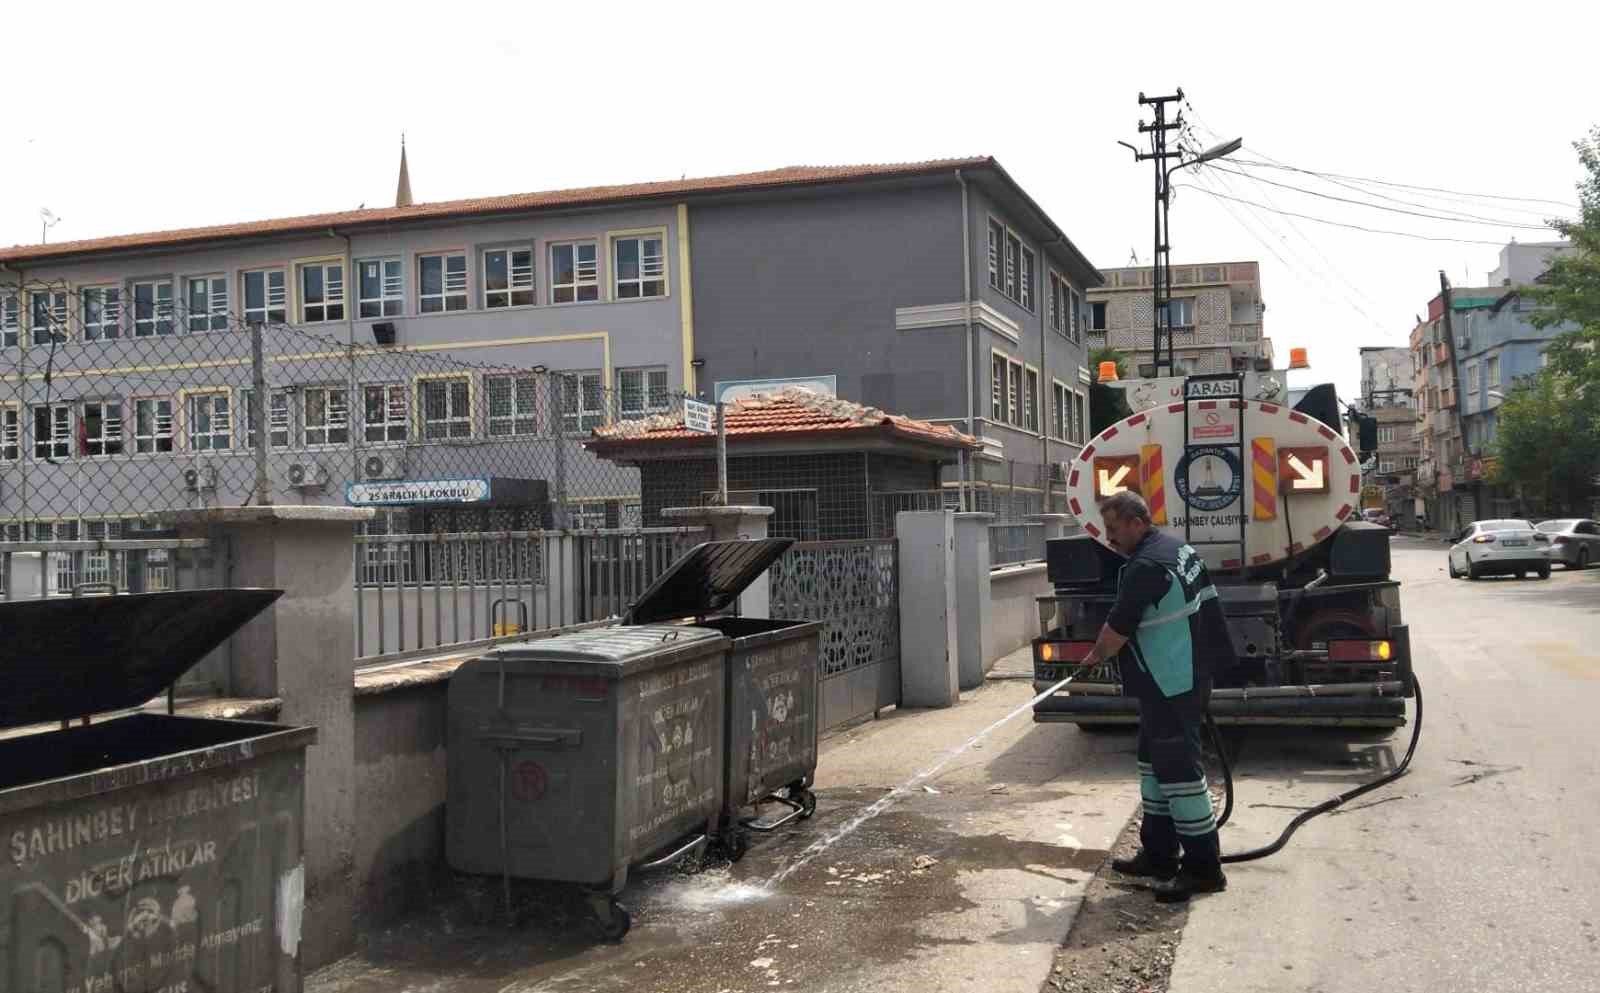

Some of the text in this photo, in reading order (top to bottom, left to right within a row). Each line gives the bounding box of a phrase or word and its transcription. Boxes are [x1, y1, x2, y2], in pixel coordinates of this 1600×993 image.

[368, 490, 380, 501] 25
[382, 489, 418, 501] ARALIK
[138, 841, 217, 881] ATIKLAR
